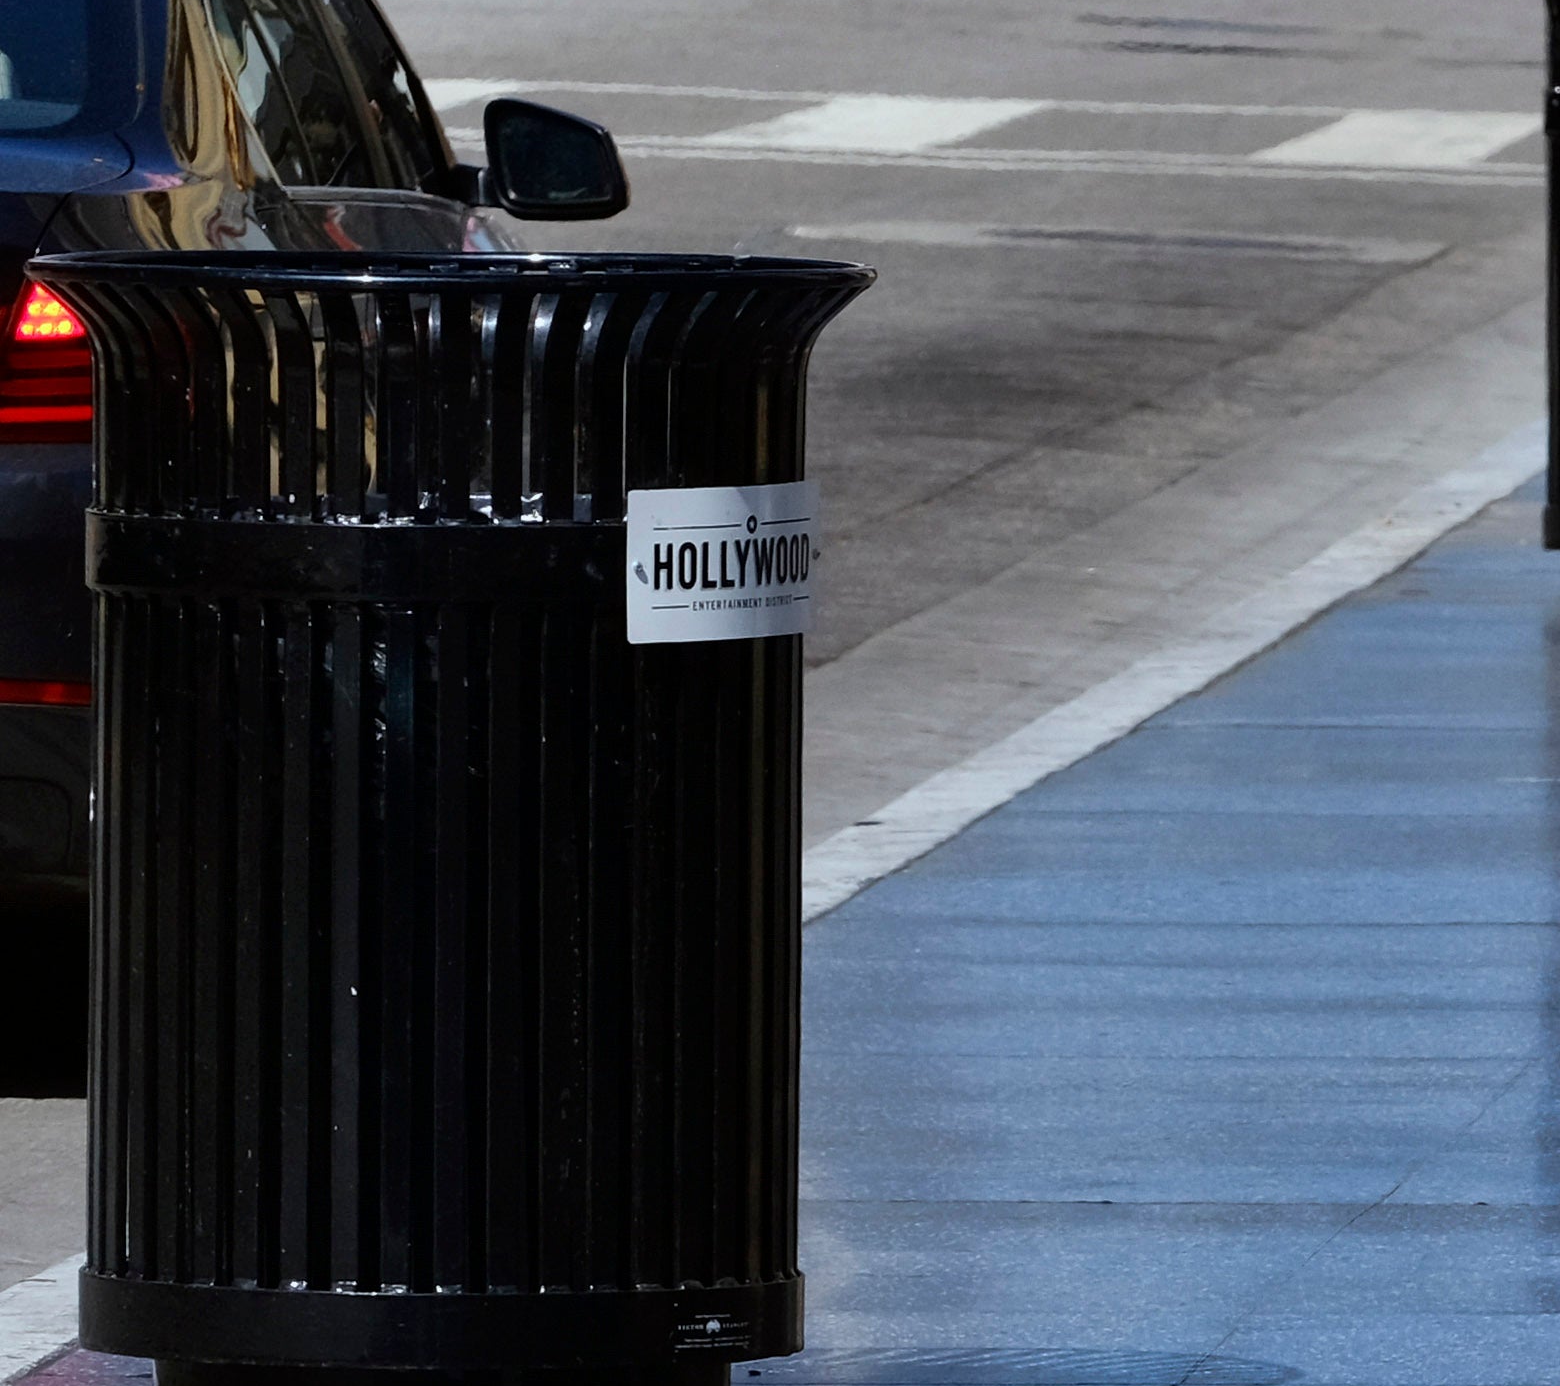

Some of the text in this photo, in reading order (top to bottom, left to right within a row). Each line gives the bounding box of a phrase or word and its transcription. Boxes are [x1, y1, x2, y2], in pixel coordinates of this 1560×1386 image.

[653, 533, 810, 590] HOLLYWOOD
[693, 595, 792, 611] ENTERTAINMENT DISTRICT
